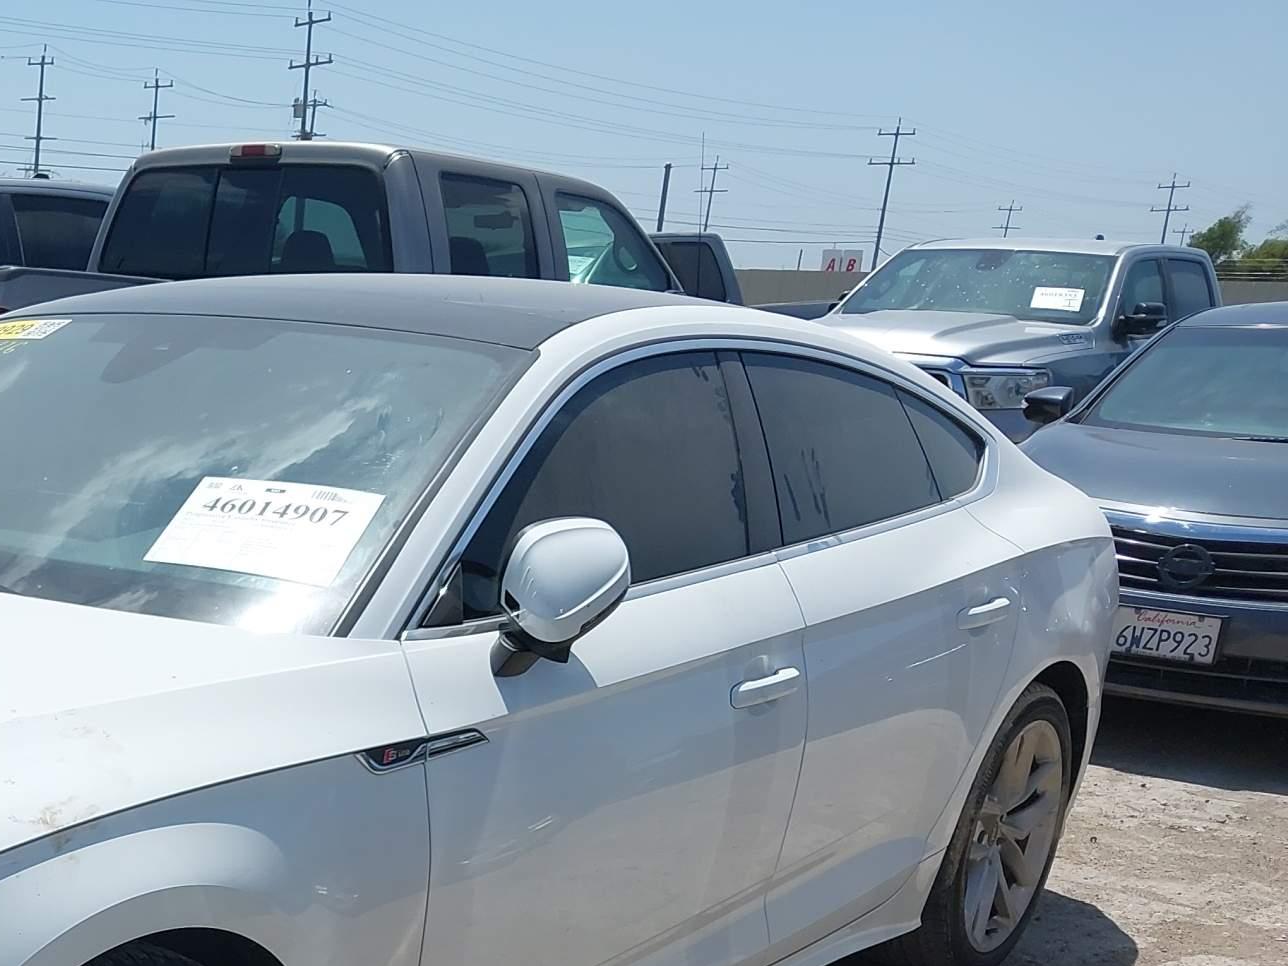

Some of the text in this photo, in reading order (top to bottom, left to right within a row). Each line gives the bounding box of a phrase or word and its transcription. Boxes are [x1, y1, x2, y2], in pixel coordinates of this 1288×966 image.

[825, 258, 836, 271] A
[846, 258, 857, 272] B
[202, 496, 350, 527] 46014907
[1137, 610, 1197, 628] California
[1115, 624, 1213, 658] 6WZP923
